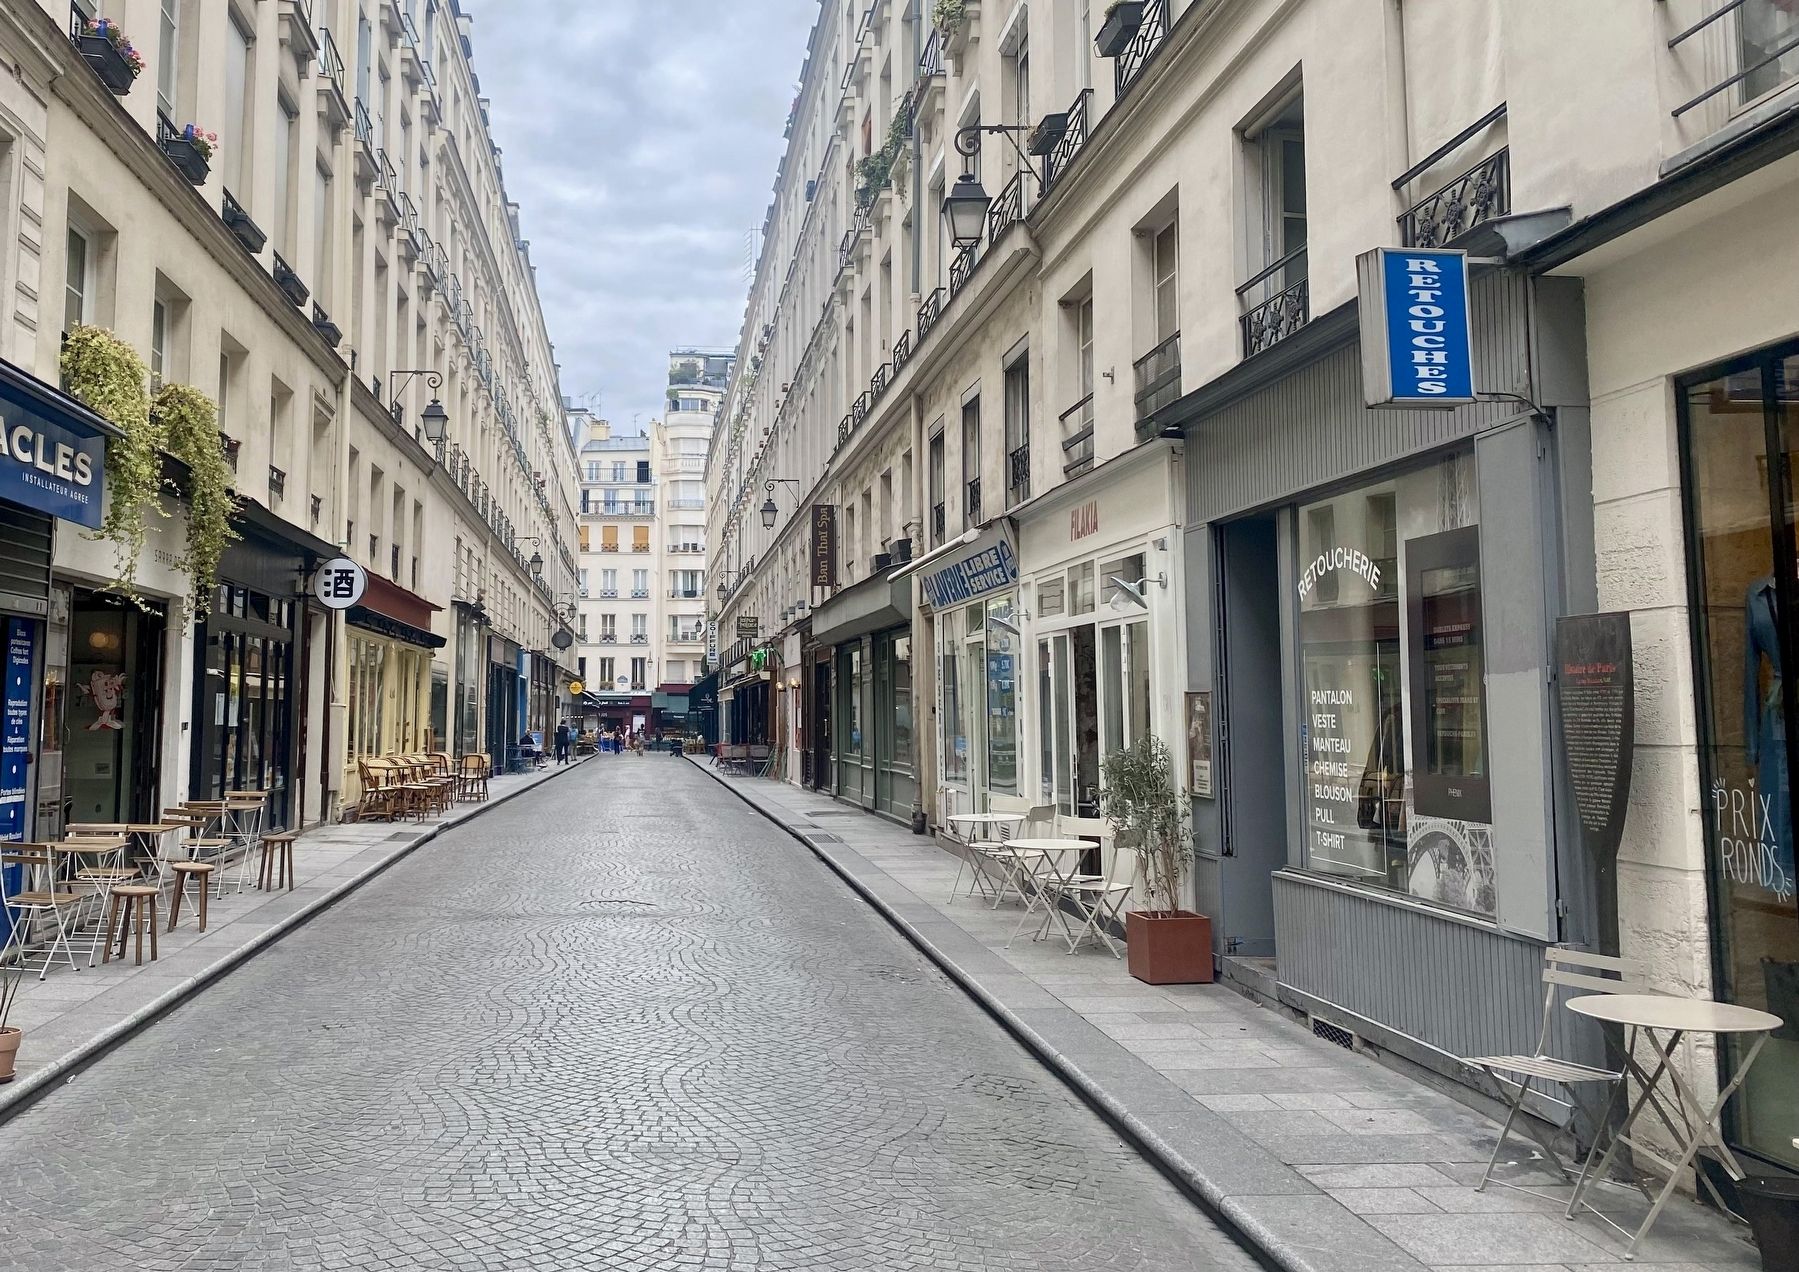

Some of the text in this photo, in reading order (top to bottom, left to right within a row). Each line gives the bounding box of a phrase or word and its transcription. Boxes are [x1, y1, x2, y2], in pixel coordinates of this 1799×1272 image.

[1405, 258, 1449, 394] RETOUCHES
[22, 472, 68, 497] INSTALLATEUR
[817, 507, 831, 528] Spa
[1070, 500, 1098, 542] FILAKIA
[323, 569, 355, 598] 酒
[818, 560, 828, 584] Ban
[929, 562, 973, 609] LAVERIE
[963, 548, 1000, 576] LIBRE
[969, 567, 1007, 593] SERVICE
[1297, 547, 1381, 602] RETOUCHERIE
[1311, 690, 1353, 705] PANTALON
[1312, 714, 1336, 729] VESTE
[1313, 737, 1351, 753] MANTEAU
[1314, 761, 1348, 777] CHEMISE
[1315, 784, 1353, 803] BLOUSON
[1316, 808, 1335, 824] PULL
[1316, 831, 1345, 850] T-SHIRT
[1721, 837, 1785, 892] RONDS
